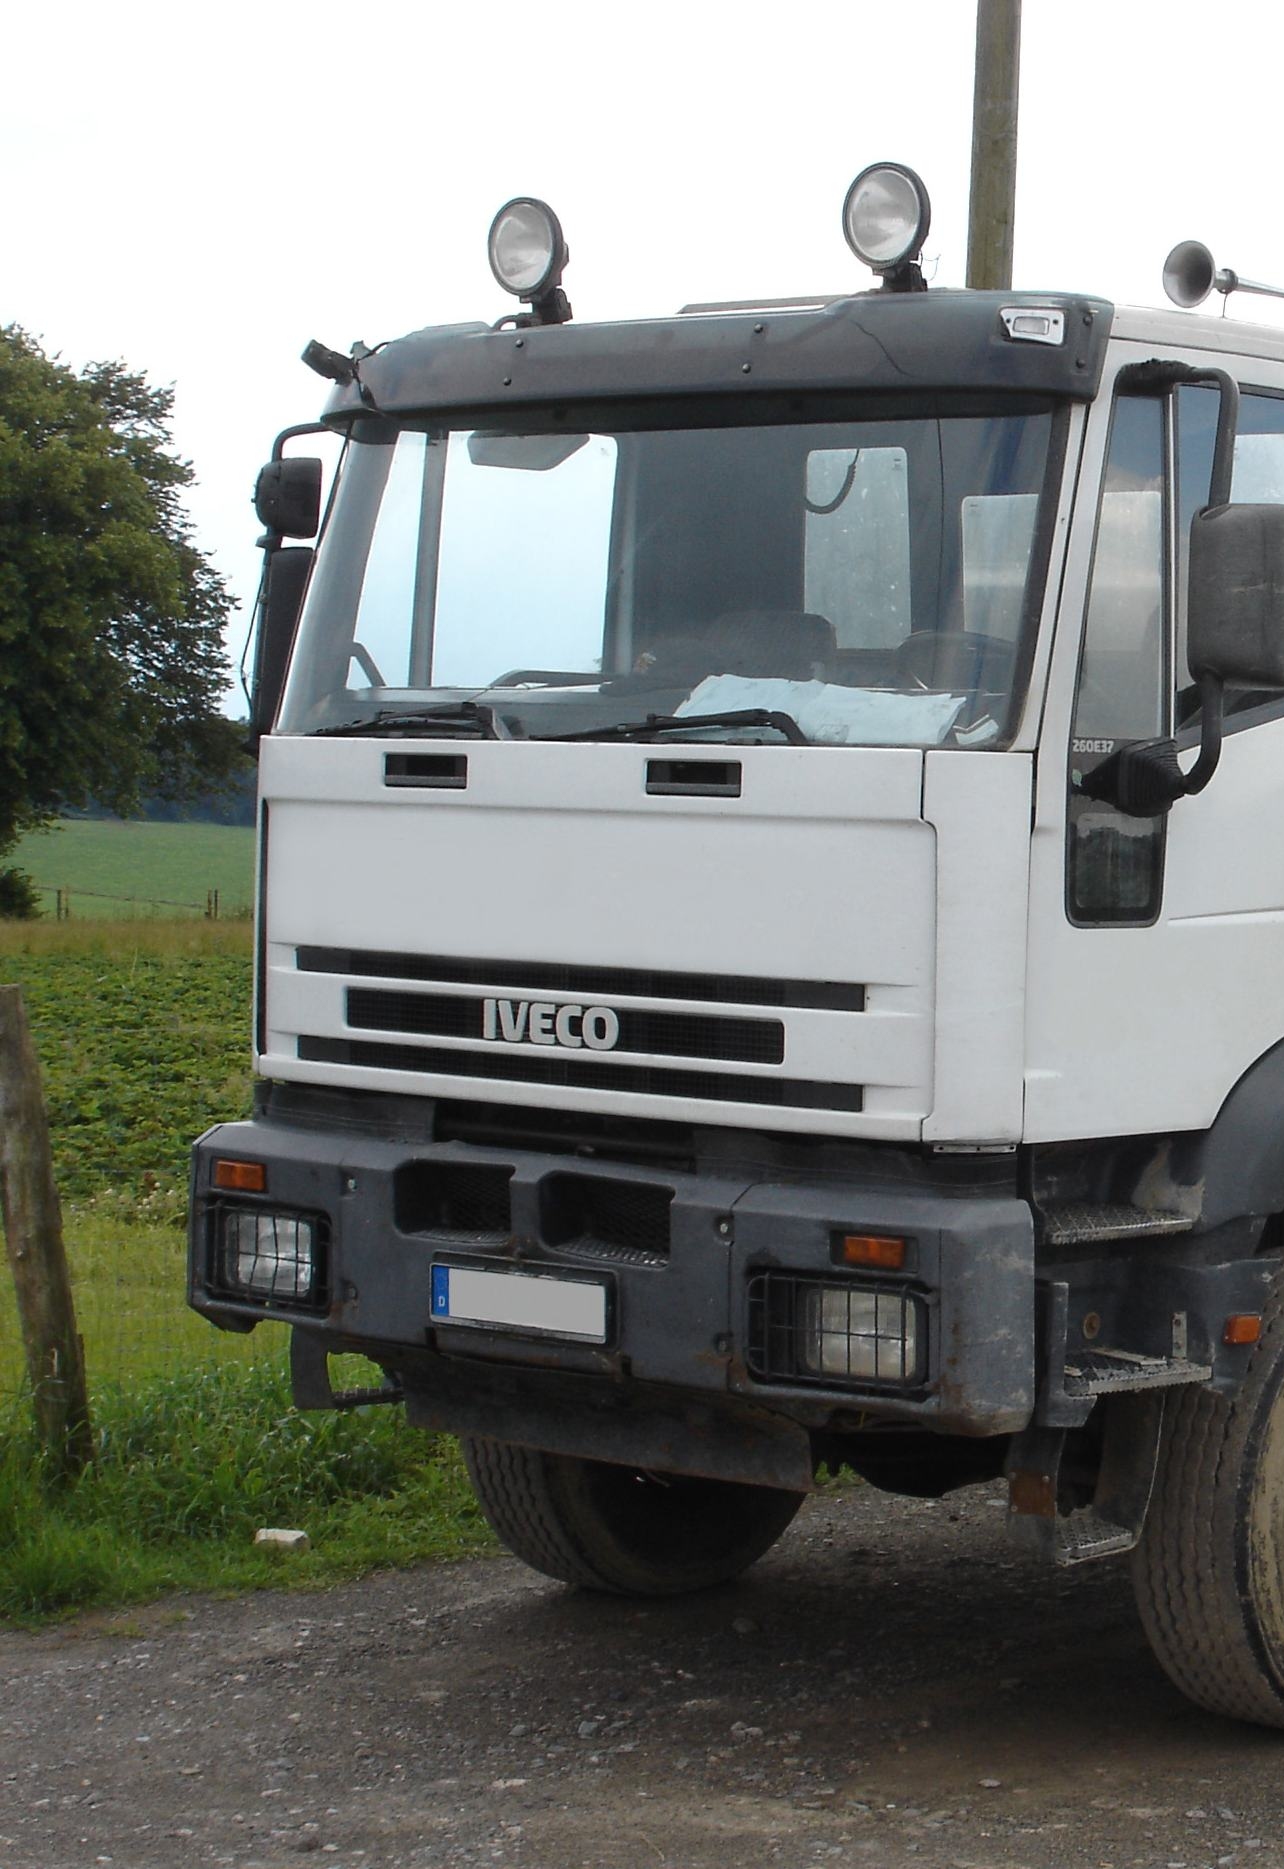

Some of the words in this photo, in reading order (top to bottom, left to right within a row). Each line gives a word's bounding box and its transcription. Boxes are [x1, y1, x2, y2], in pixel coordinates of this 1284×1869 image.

[1072, 739, 1114, 753] 260E37
[483, 998, 620, 1050] IVECO
[438, 1295, 446, 1307] D
